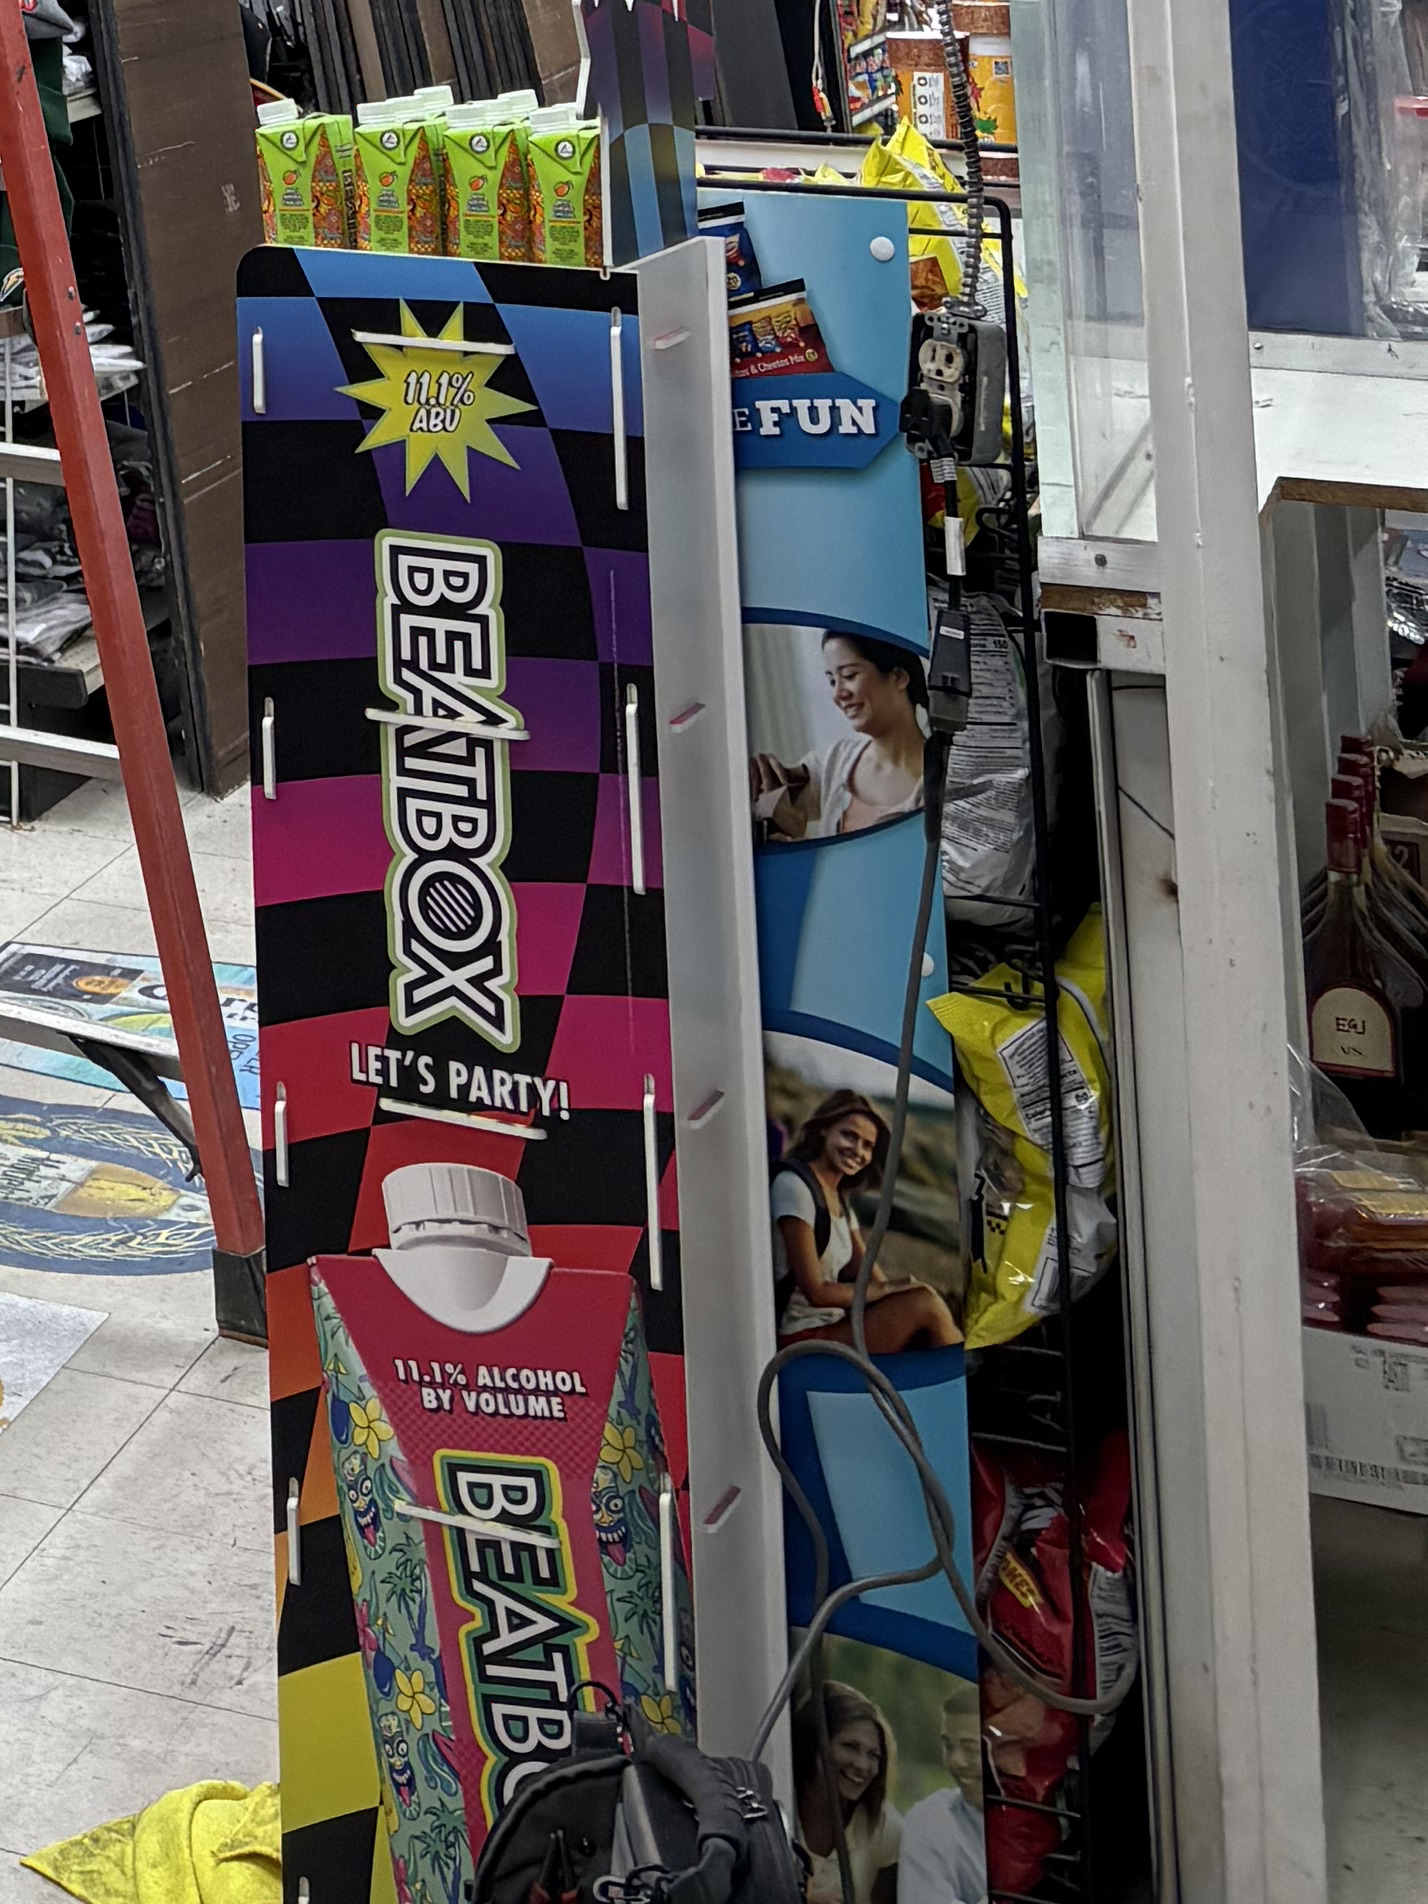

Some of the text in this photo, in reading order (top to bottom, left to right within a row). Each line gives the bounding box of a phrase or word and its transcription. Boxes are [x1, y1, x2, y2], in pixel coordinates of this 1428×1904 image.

[405, 371, 475, 406] 11.1%
[759, 397, 875, 435] FUN
[389, 543, 512, 1045] BEATBOX
[350, 1042, 572, 1121] LET'S PARTY!
[394, 1359, 586, 1394] 11.1% ALCOHOL
[421, 1387, 566, 1420] BY VOLUME
